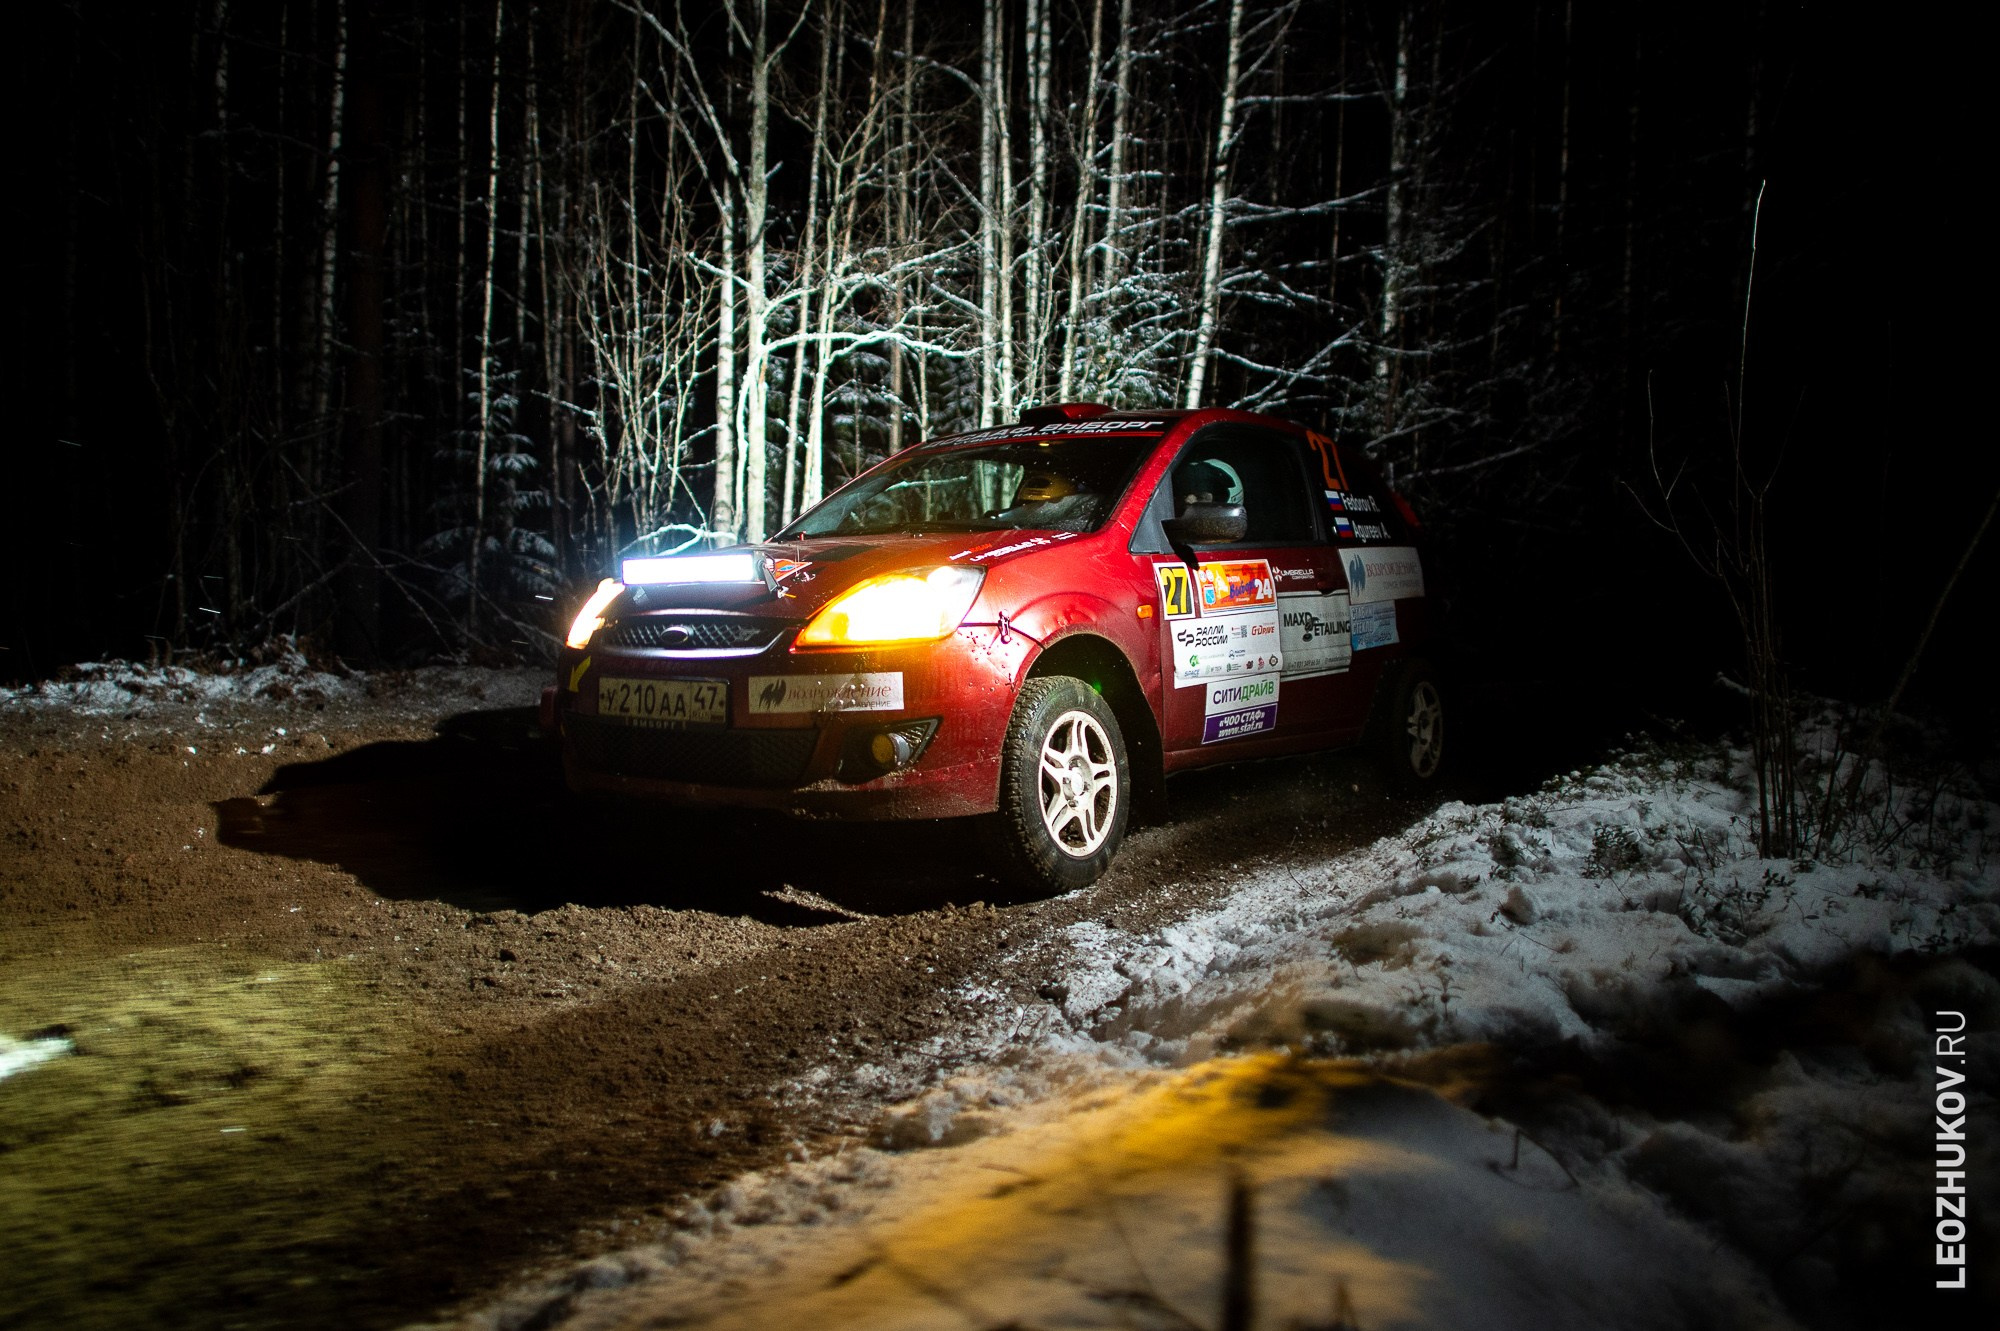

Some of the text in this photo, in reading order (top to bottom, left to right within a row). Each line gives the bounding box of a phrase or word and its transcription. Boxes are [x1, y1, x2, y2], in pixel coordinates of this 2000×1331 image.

[1306, 430, 1350, 491] 27
[1280, 568, 1315, 577] UMBRELLA
[1160, 567, 1190, 615] 27
[1254, 578, 1273, 600] 24
[1196, 625, 1224, 636] РАЛЛИ
[1195, 635, 1228, 648] РОССИИ
[1213, 679, 1275, 704] СИТИДРАЙВ
[1218, 721, 1264, 737] www.staf.ru
